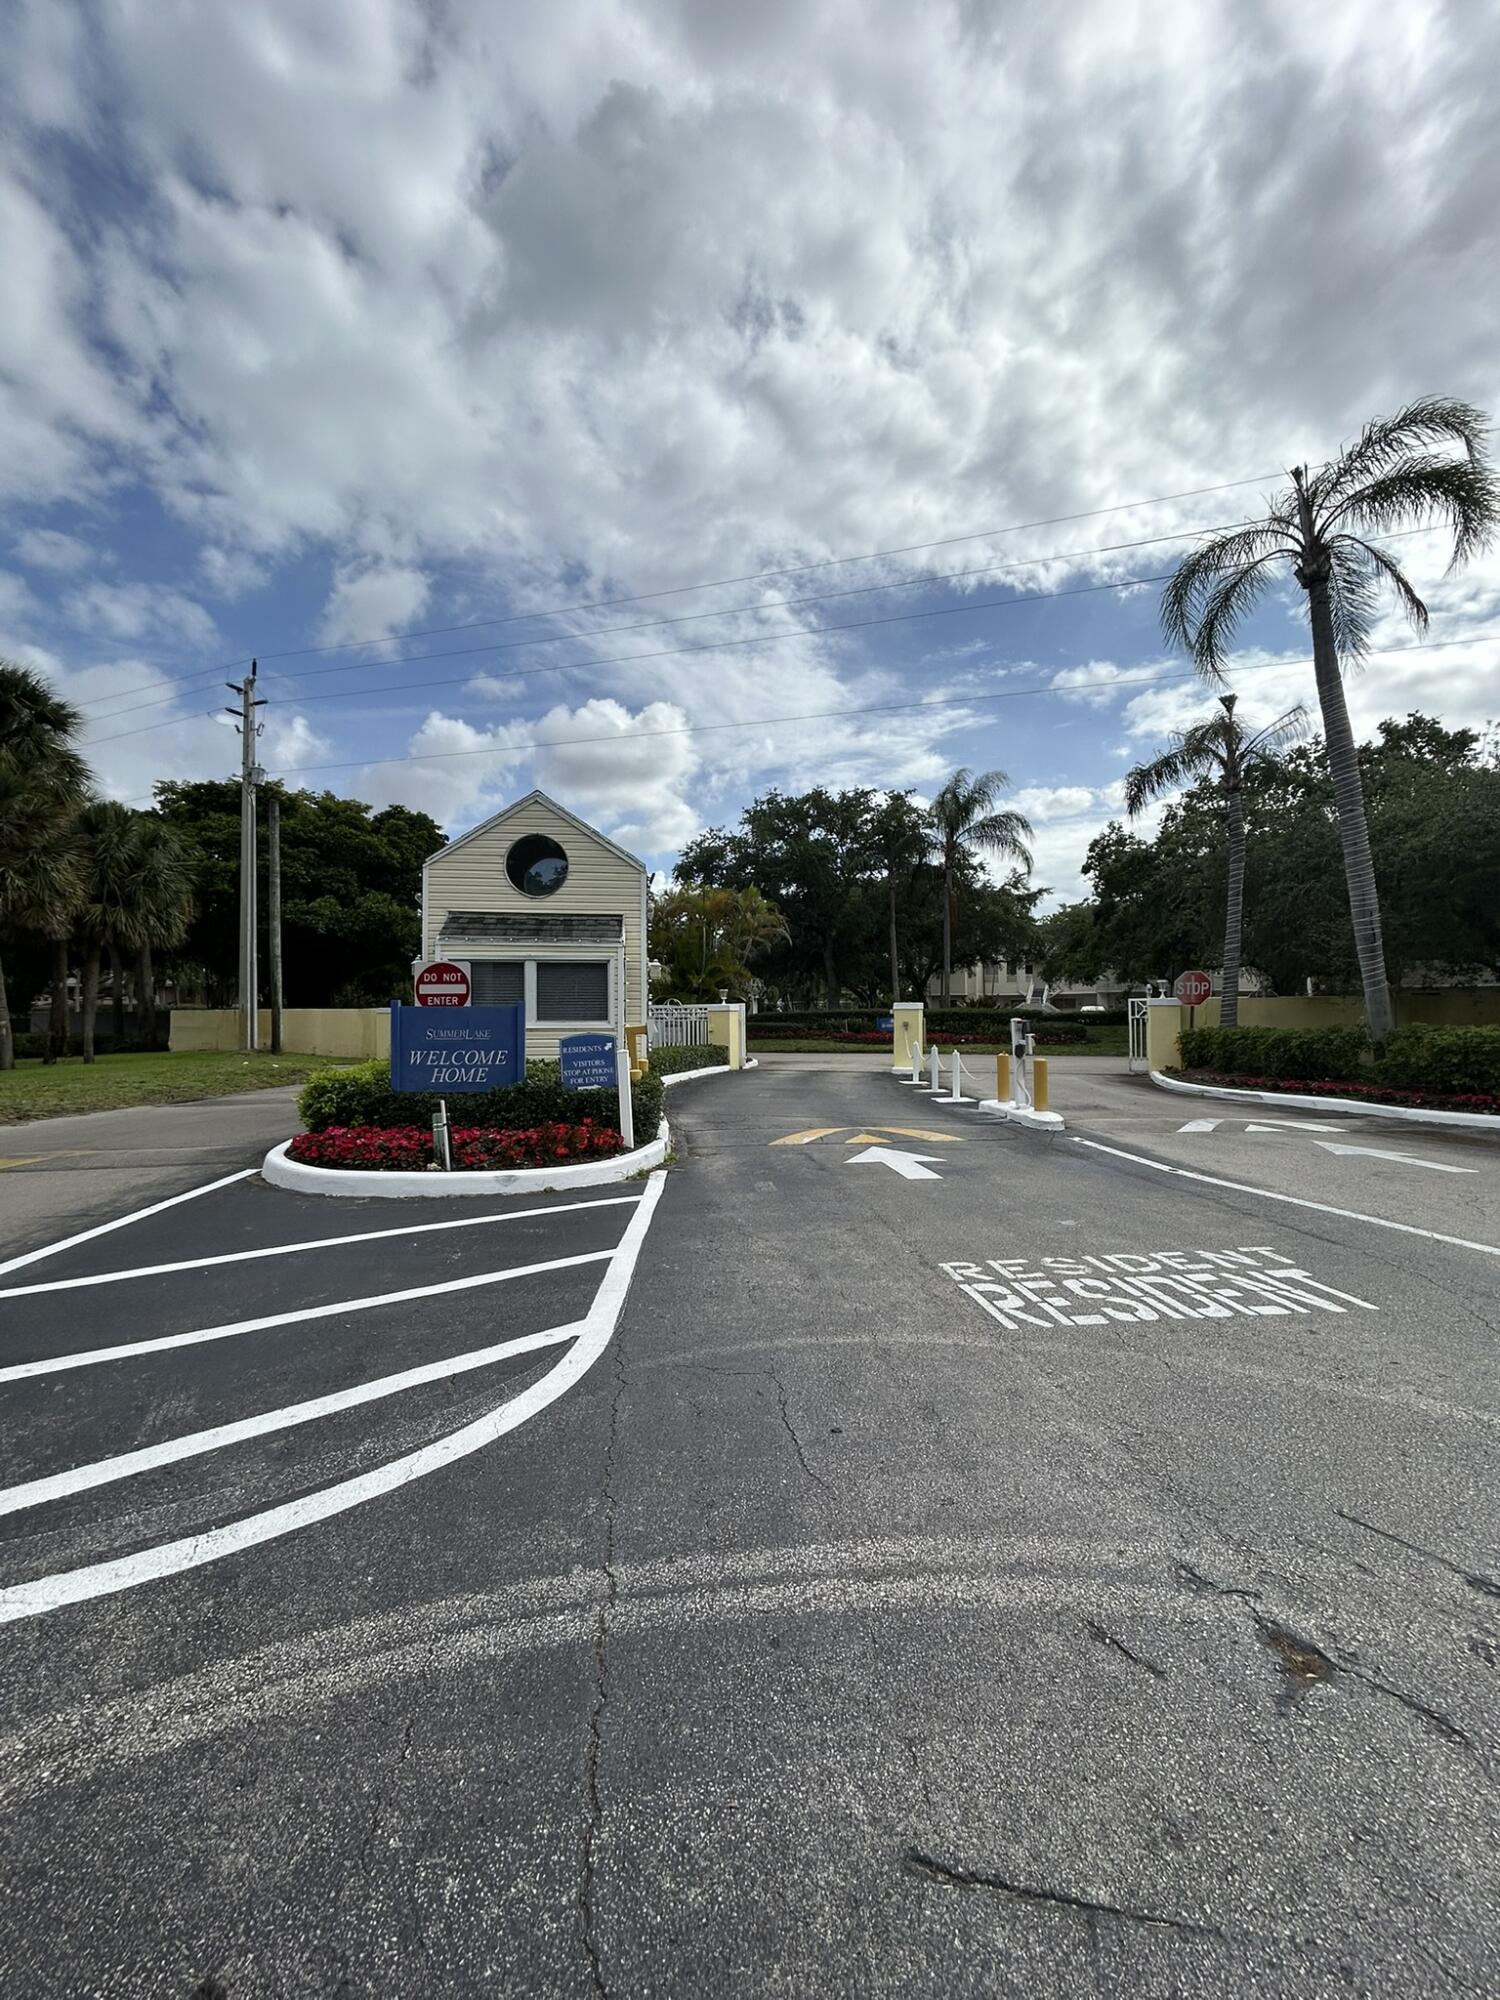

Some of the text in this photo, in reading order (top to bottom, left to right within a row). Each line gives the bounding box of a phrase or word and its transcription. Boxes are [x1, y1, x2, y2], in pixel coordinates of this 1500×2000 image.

[423, 972, 462, 982] DO NOT
[1177, 982, 1209, 995] STOP
[427, 996, 459, 1006] ENTER
[562, 1045, 602, 1053] RESIDENTS
[409, 1049, 508, 1066] WELCOME
[431, 1067, 488, 1083] HOME
[592, 1067, 613, 1075] PHONE
[937, 1245, 1296, 1283] RESIDENT
[957, 1267, 1380, 1330] RESIDENT
